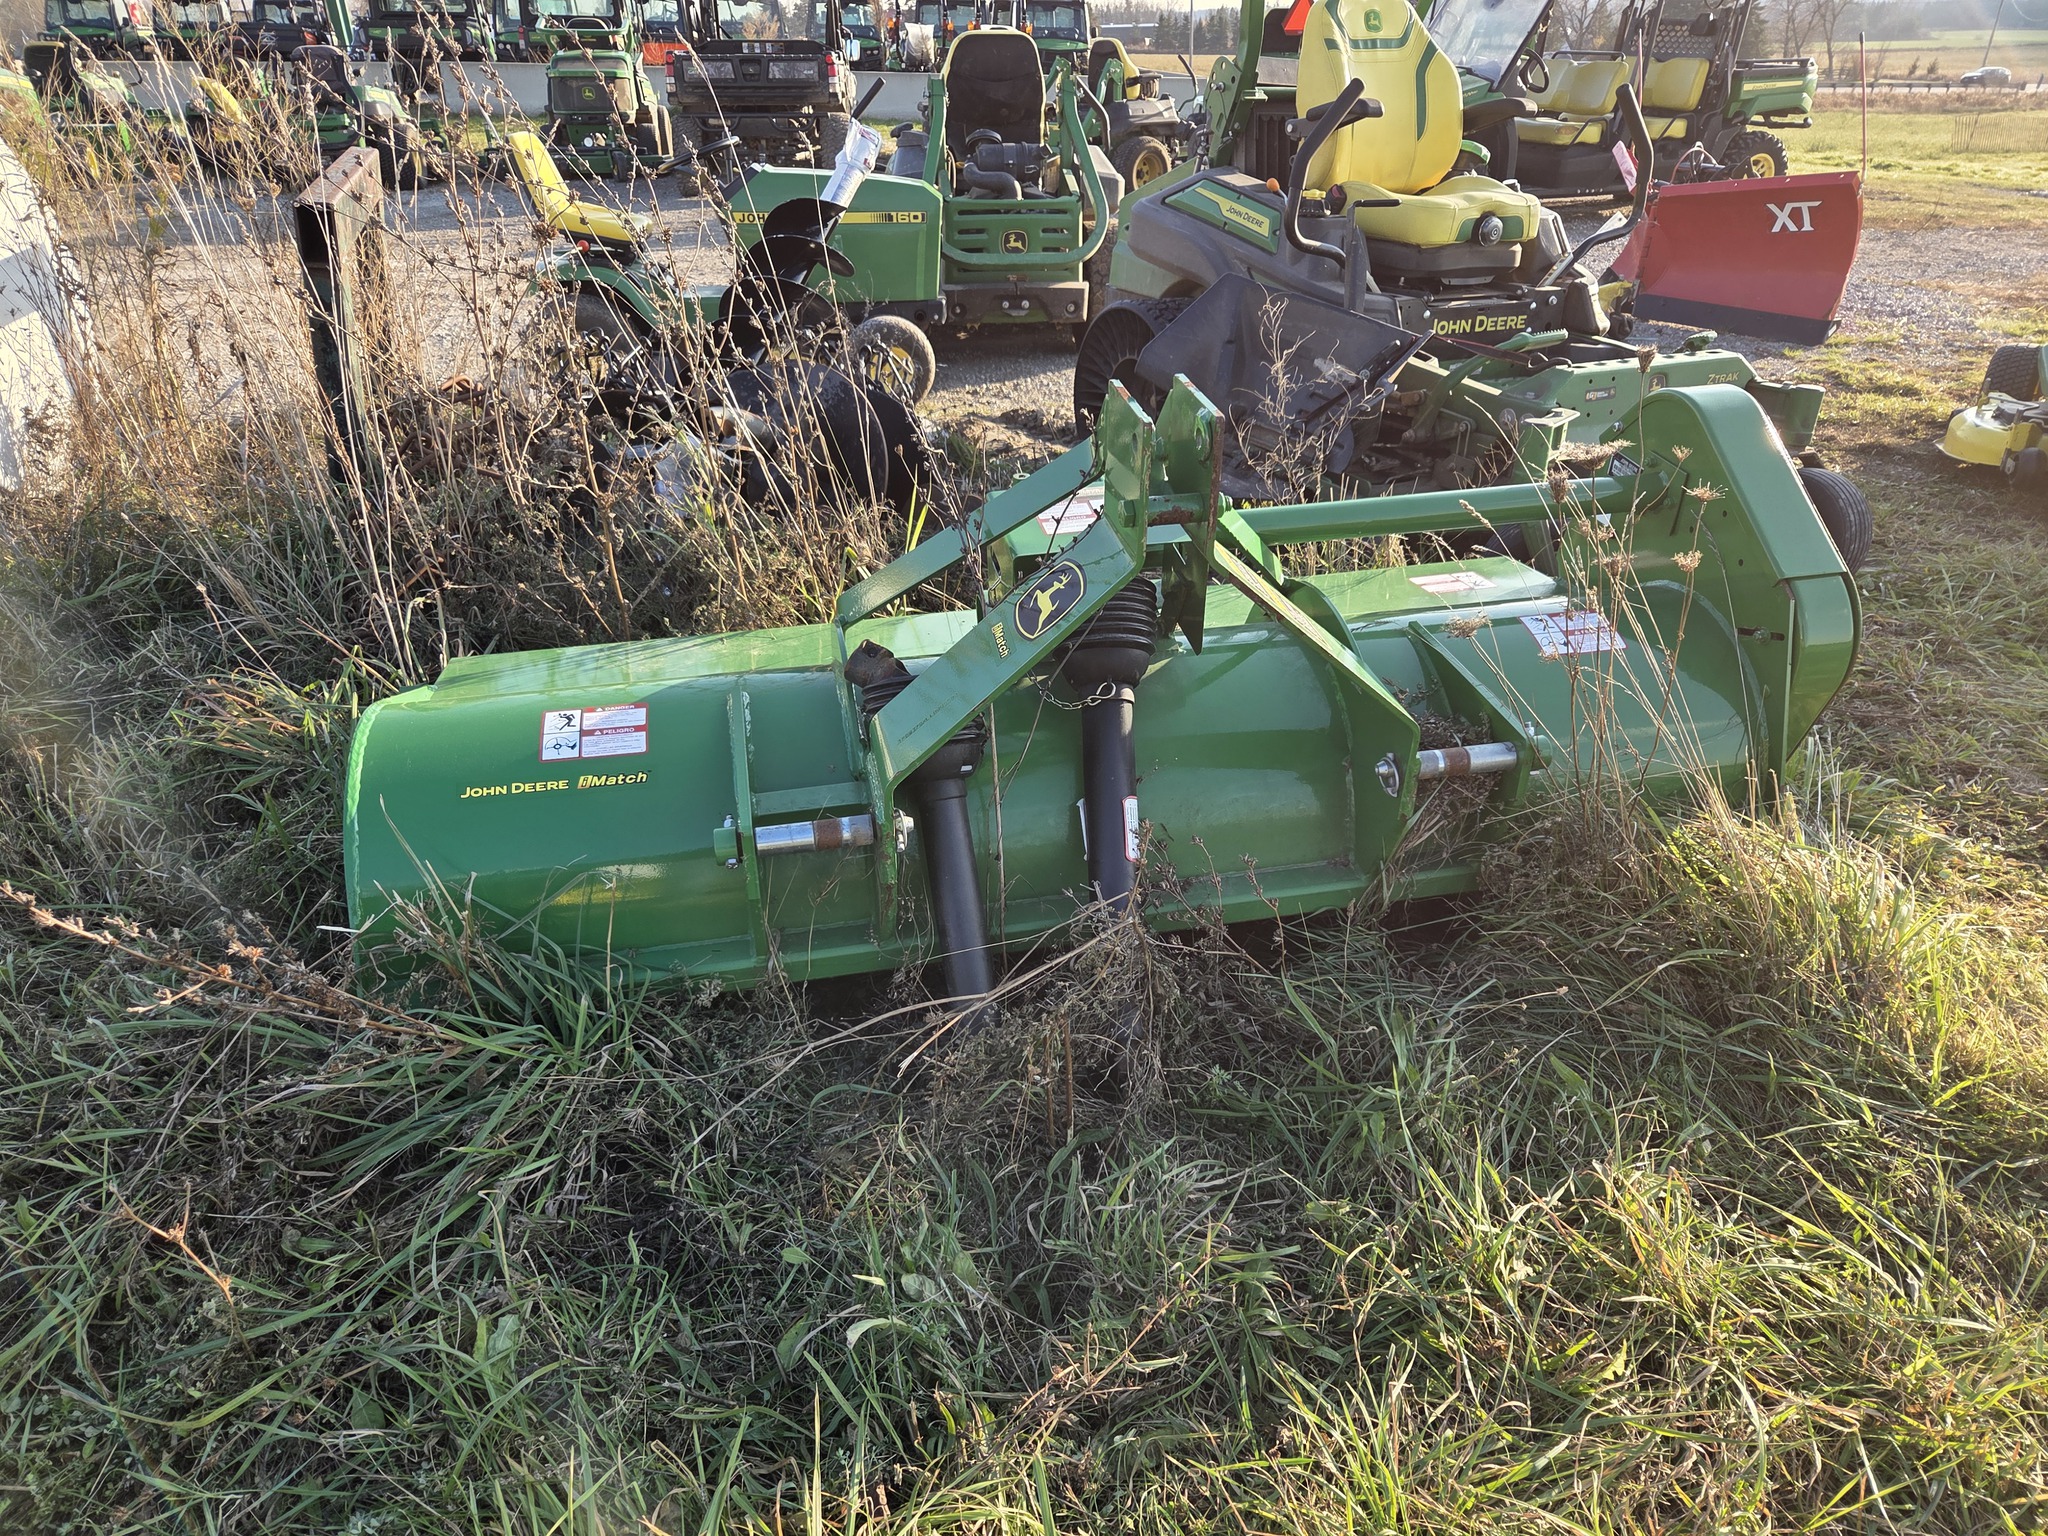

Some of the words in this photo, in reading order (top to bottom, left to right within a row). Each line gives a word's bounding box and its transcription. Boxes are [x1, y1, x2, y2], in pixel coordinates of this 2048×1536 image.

[739, 213, 768, 223] JOH
[890, 211, 922, 223] 160
[1226, 204, 1243, 219] JOHN
[1242, 212, 1264, 229] DEERE
[1766, 201, 1823, 233] XT
[1433, 318, 1472, 335] JOHN
[1474, 315, 1527, 333] DEERE
[1707, 371, 1740, 385] ZTRAK
[603, 727, 635, 736] PELIGRO
[460, 785, 508, 799] JOHN
[511, 780, 569, 794] DEERE
